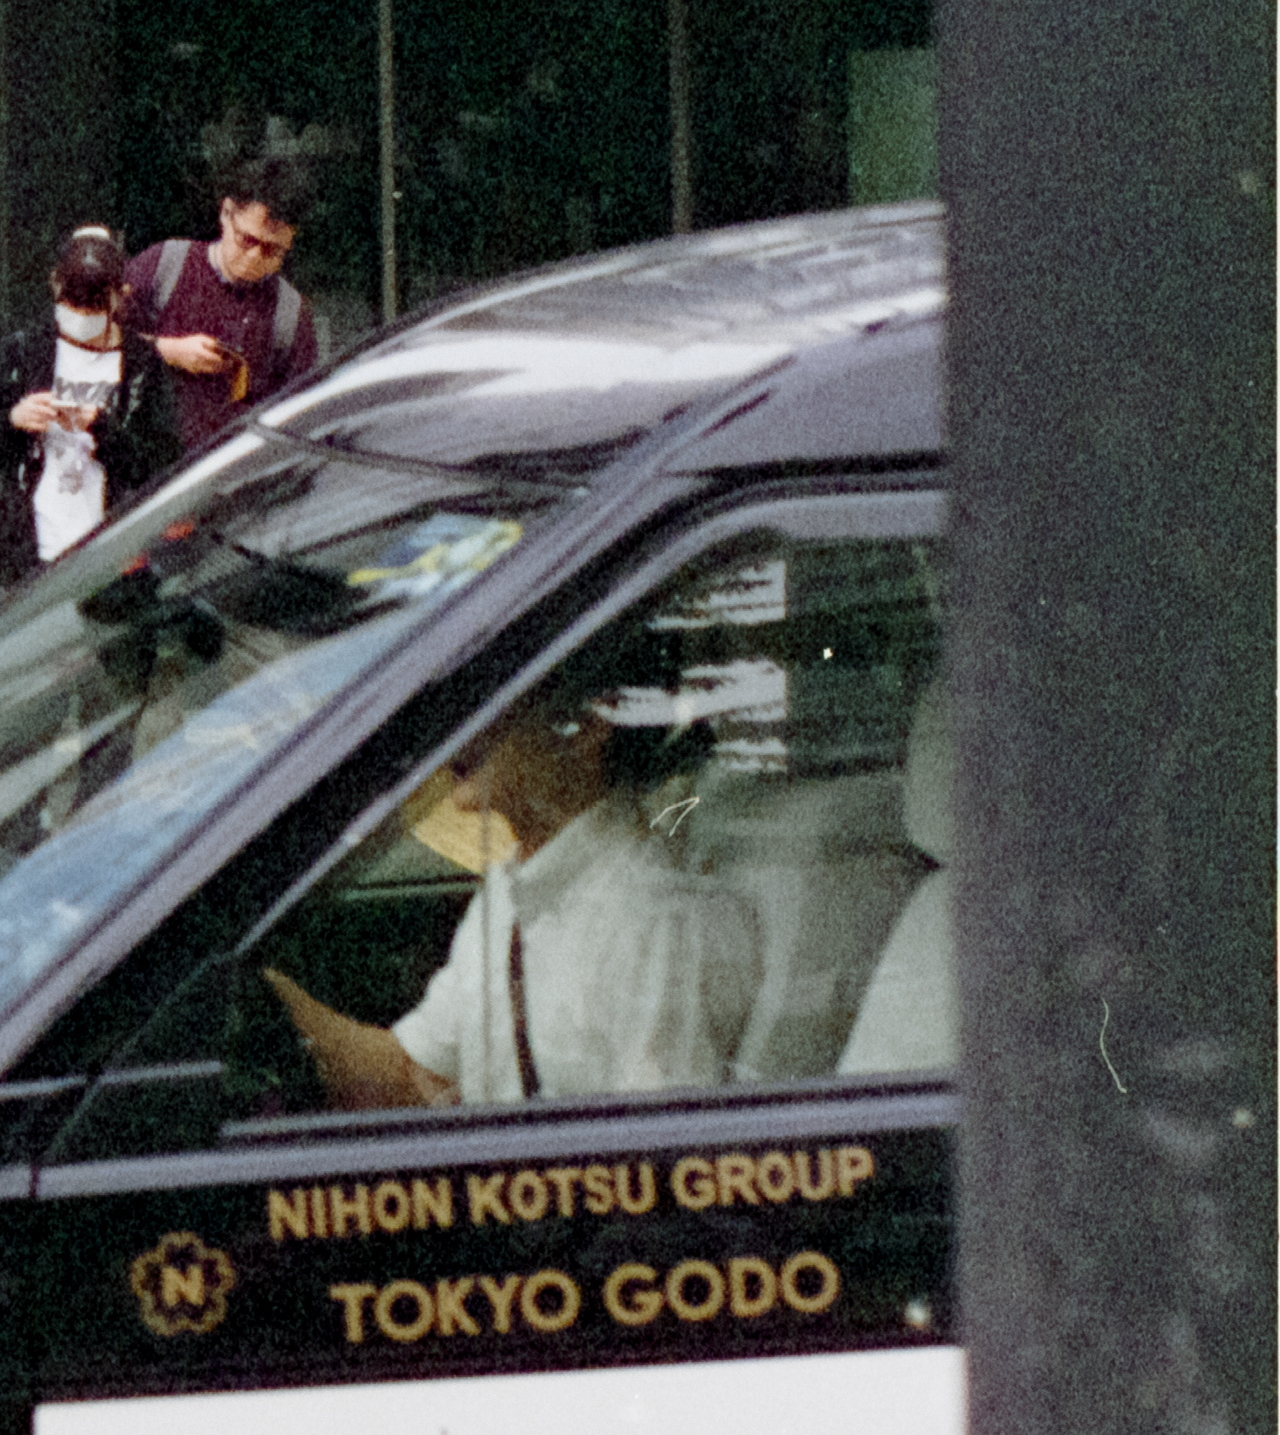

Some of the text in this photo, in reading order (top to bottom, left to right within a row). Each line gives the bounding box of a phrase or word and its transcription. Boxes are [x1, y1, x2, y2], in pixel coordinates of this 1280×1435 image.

[267, 1145, 874, 1241] NIHON KOTSU GROUP
[330, 1250, 840, 1343] TOKYO GODO
